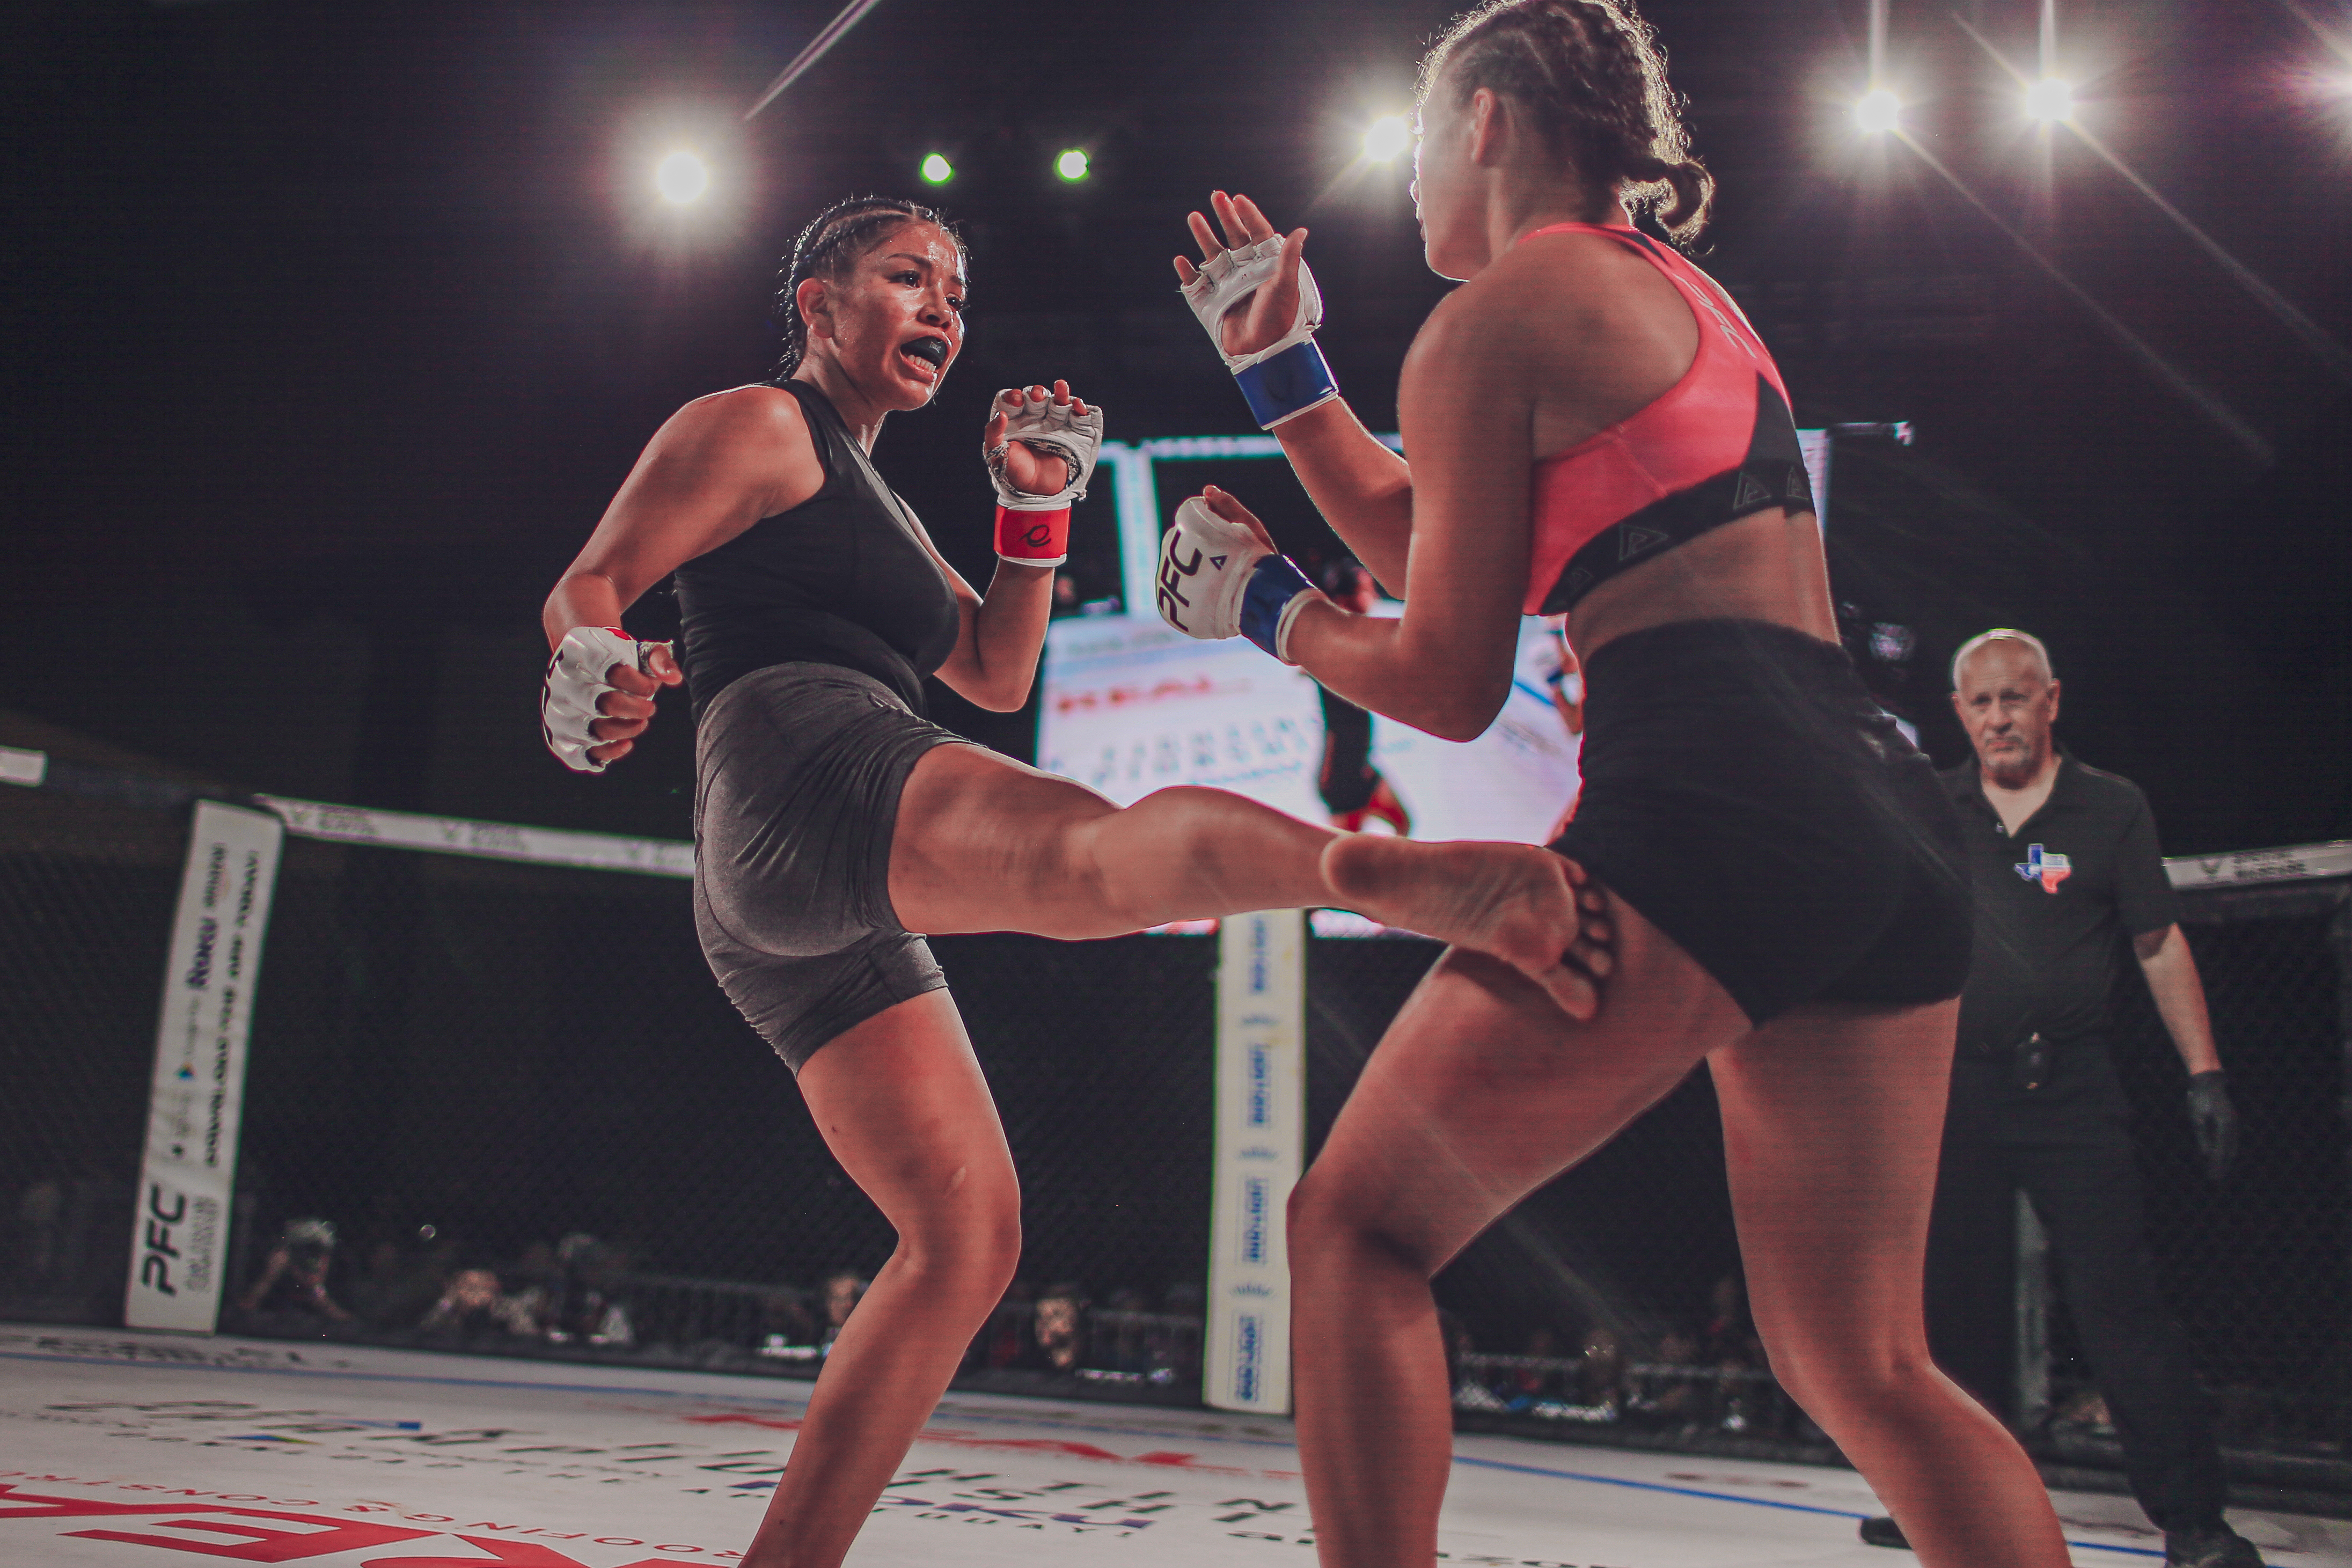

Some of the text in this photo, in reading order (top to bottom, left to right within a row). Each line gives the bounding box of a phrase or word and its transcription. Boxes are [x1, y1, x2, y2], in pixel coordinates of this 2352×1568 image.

[1159, 530, 1203, 633] PFC
[142, 1183, 187, 1296] PFC
[403, 1512, 745, 1559] ROOFING
